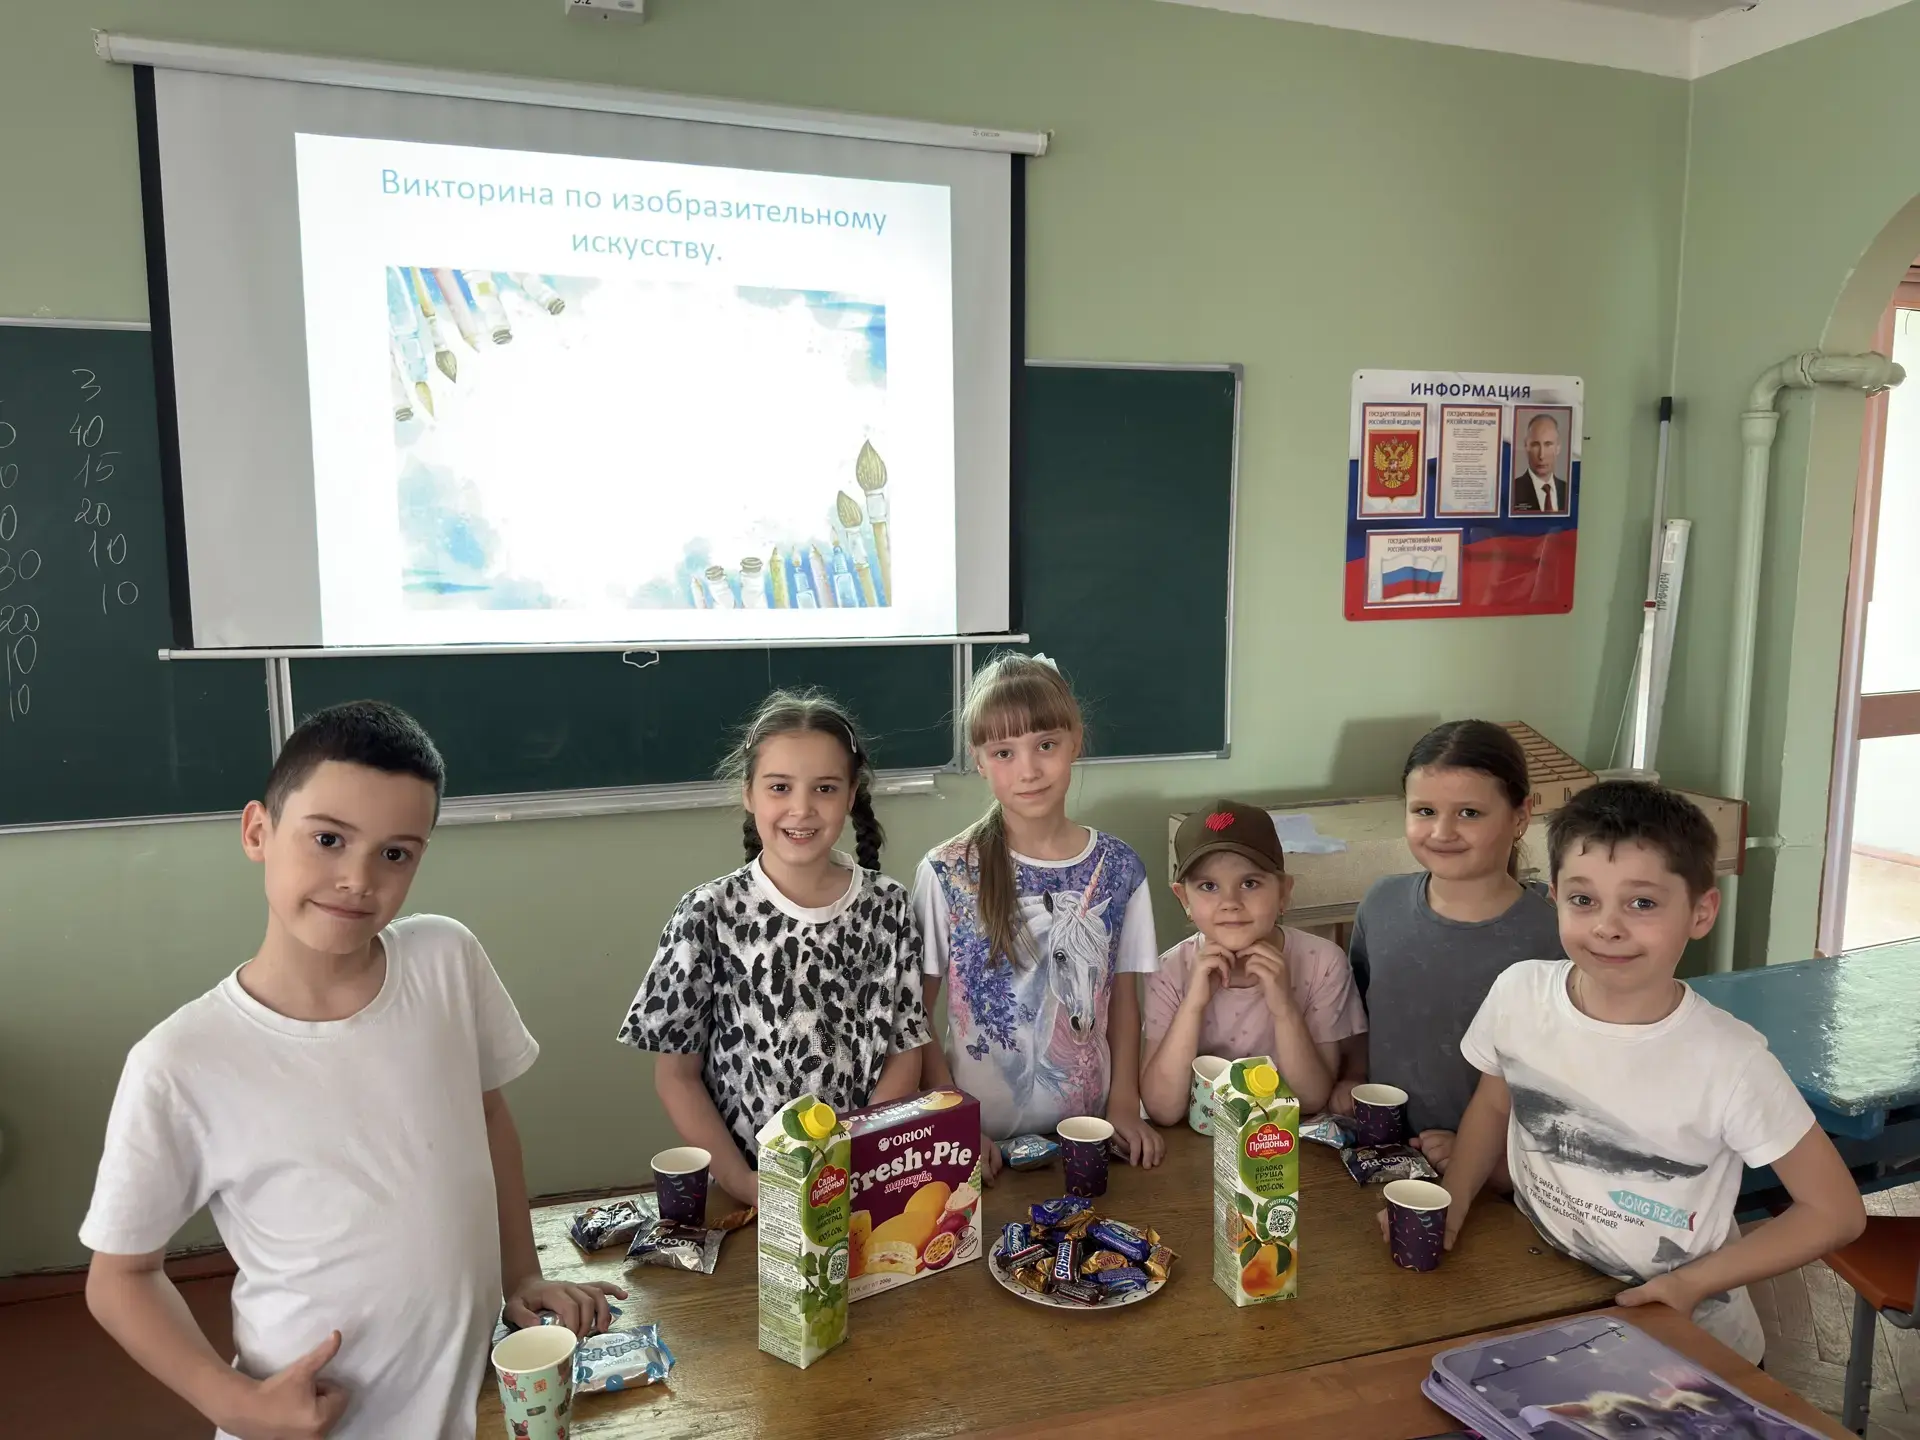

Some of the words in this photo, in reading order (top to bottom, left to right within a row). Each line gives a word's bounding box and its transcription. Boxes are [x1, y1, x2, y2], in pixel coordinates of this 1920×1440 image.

[382, 168, 554, 207] Викторина
[566, 189, 602, 209] по
[612, 189, 887, 236] изобразительному
[572, 233, 723, 267] искусству.
[72, 368, 102, 402] 3
[1410, 382, 1532, 401] ИНФОРМАЦИЯ
[69, 413, 104, 448] 40
[74, 451, 122, 488] 15
[75, 498, 111, 527] 20
[89, 530, 127, 567] 10
[103, 581, 138, 615] 10
[6, 634, 37, 686] 10
[9, 683, 30, 722] 10
[893, 1126, 932, 1146] ORION
[1249, 1140, 1290, 1152] Придонья
[1257, 1133, 1280, 1142] Сады
[1255, 1164, 1284, 1173] ЯБЛОКО
[1255, 1171, 1284, 1180] ГРУША
[812, 1178, 845, 1200] Придонья
[817, 1174, 837, 1188] Сады
[884, 1170, 933, 1194] маракуйя
[1594, 1203, 1622, 1220] REQUIEM
[1624, 1215, 1645, 1227] SHARK
[1618, 1191, 1650, 1215] LONG
[1591, 1215, 1618, 1229] MEMBER
